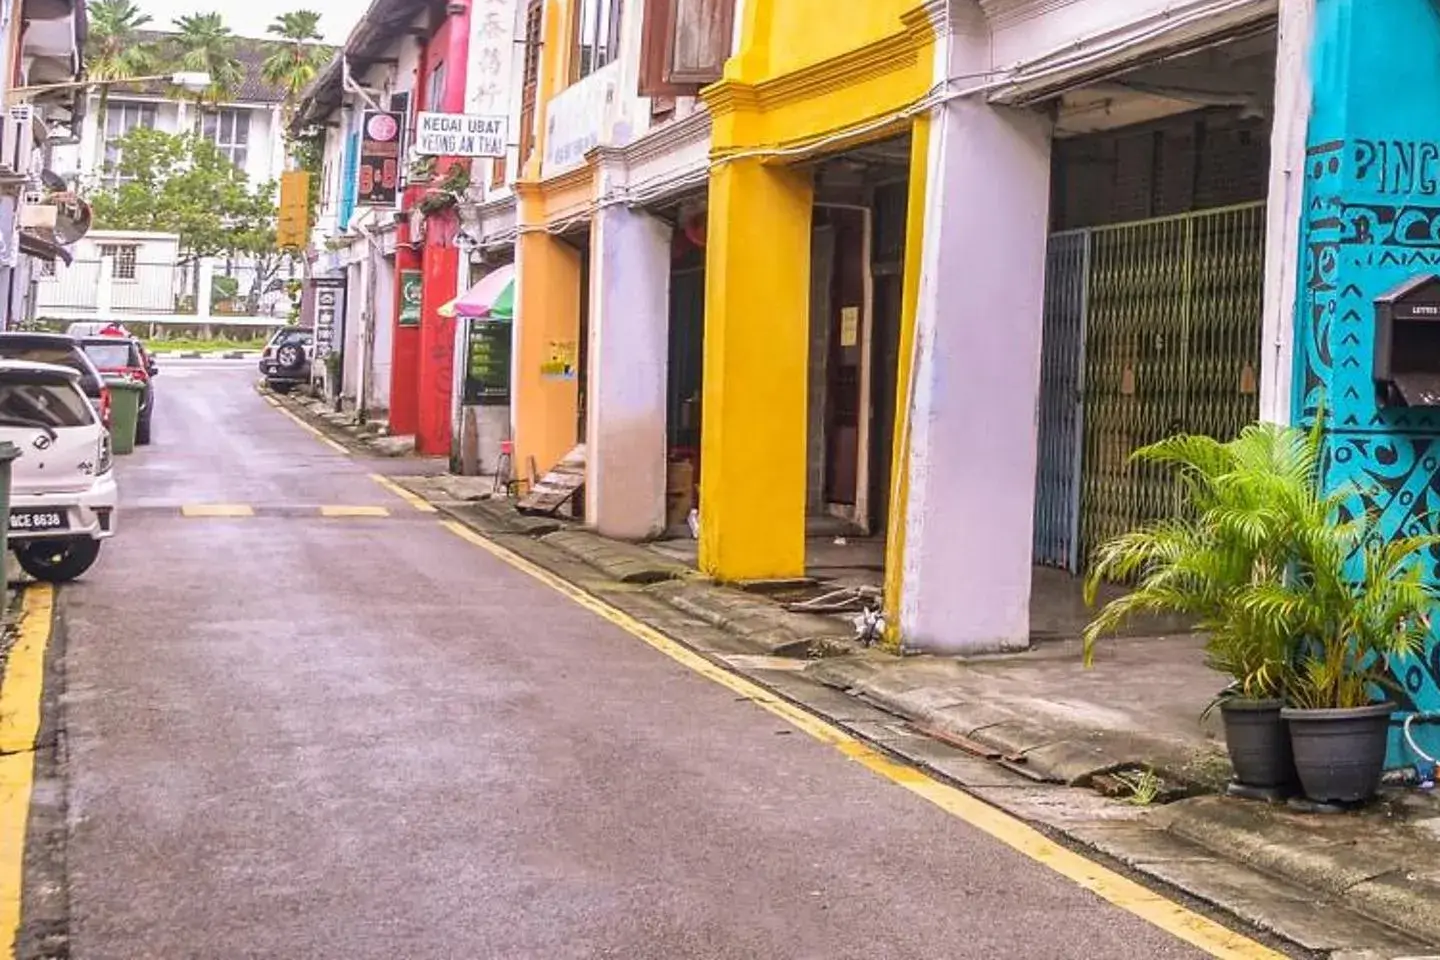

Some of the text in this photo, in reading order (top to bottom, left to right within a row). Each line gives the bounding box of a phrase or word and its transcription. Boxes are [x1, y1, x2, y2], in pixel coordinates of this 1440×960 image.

[423, 117, 502, 134] KEDAI UBAT
[459, 135, 474, 153] AN
